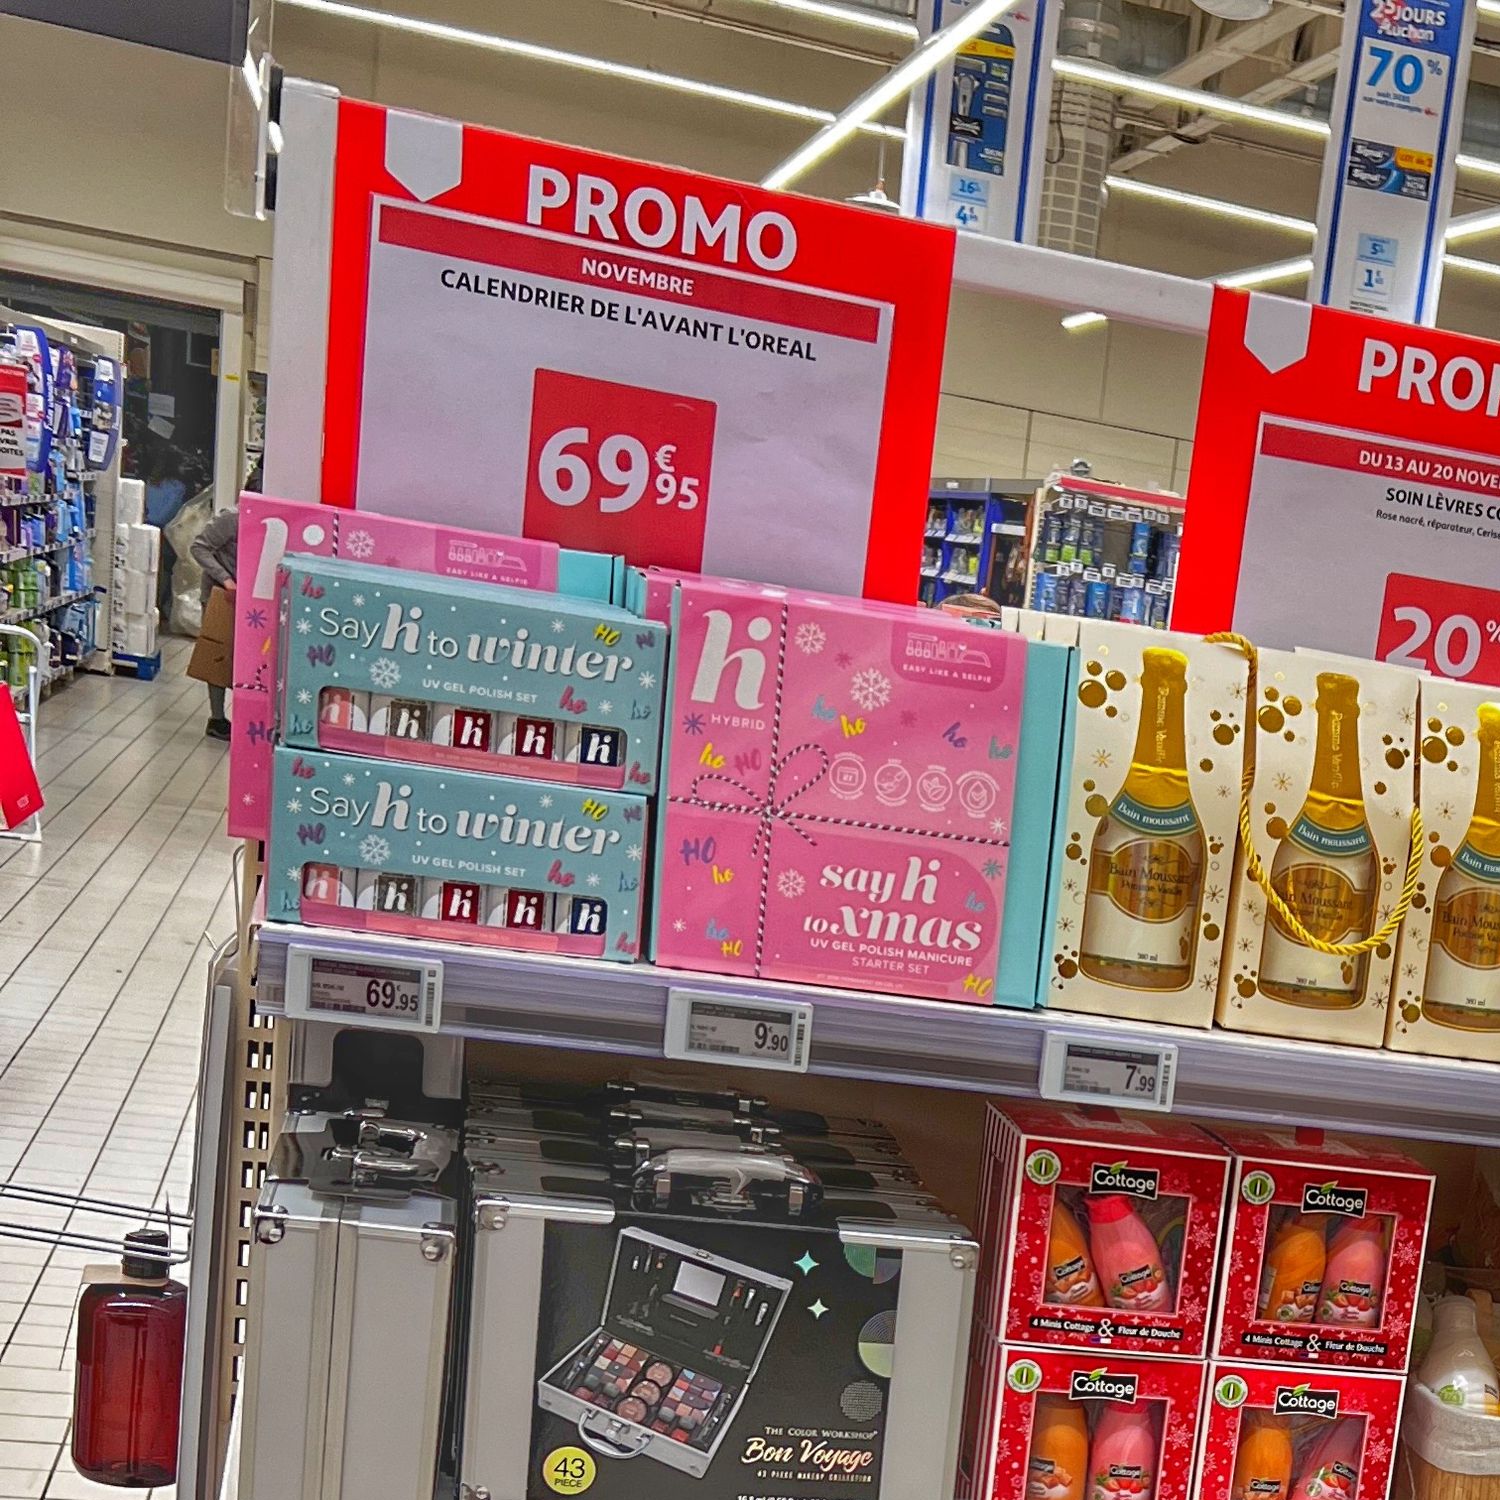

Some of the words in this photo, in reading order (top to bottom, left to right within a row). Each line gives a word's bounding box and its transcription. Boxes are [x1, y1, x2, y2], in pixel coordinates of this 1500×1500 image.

[526, 164, 798, 271] PROMO
[581, 257, 694, 295] NOVEMBRE
[441, 269, 584, 315] CALENDRIER
[590, 298, 619, 321] DE
[625, 303, 723, 342] L'AVANT
[728, 327, 816, 361] L'OREAL
[1359, 450, 1382, 468] DU
[1385, 454, 1404, 471] 13
[1406, 458, 1430, 476] AU
[1433, 464, 1453, 479] 20
[1386, 488, 1423, 506] SOIN
[1427, 492, 1483, 517] LÈVRES
[1376, 509, 1397, 522] Rose
[319, 607, 378, 647] Say
[381, 603, 425, 655] hi
[427, 631, 459, 657] to
[467, 628, 634, 683] winter
[691, 610, 773, 711] hi
[903, 664, 927, 674] EASY
[930, 668, 951, 677] LIKE
[962, 672, 992, 684] SELFIE
[422, 679, 440, 689] UV
[443, 680, 466, 693] GEL
[470, 683, 513, 701] POLISH
[515, 692, 538, 703] SET
[711, 713, 765, 731] HYBRID
[310, 787, 368, 826] Say
[371, 782, 413, 833] hi
[417, 809, 448, 835] to
[457, 803, 622, 856] winter
[1118, 803, 1140, 820] Bain
[1142, 812, 1190, 826] moussant
[1461, 851, 1482, 866] Bain
[820, 863, 896, 903] say
[901, 857, 941, 905] hi
[803, 915, 829, 933] to
[829, 905, 982, 951] xmas
[810, 938, 829, 949] UV
[832, 941, 855, 953] GEL
[859, 944, 904, 959] POLISH
[907, 950, 973, 967] MANICURE
[851, 956, 904, 971] STARTER
[908, 964, 930, 975] SET
[1094, 1169, 1156, 1193] Cottage
[1306, 1188, 1363, 1210] Cottage
[1074, 1375, 1134, 1397] Cottage
[1278, 1393, 1335, 1414] Cottage
[765, 1426, 783, 1436] THE
[788, 1427, 818, 1437] COLOR
[741, 1437, 793, 1463] Bon
[800, 1439, 873, 1472] Voyage
[554, 1456, 585, 1479] 43
[554, 1478, 582, 1489] PIECE
